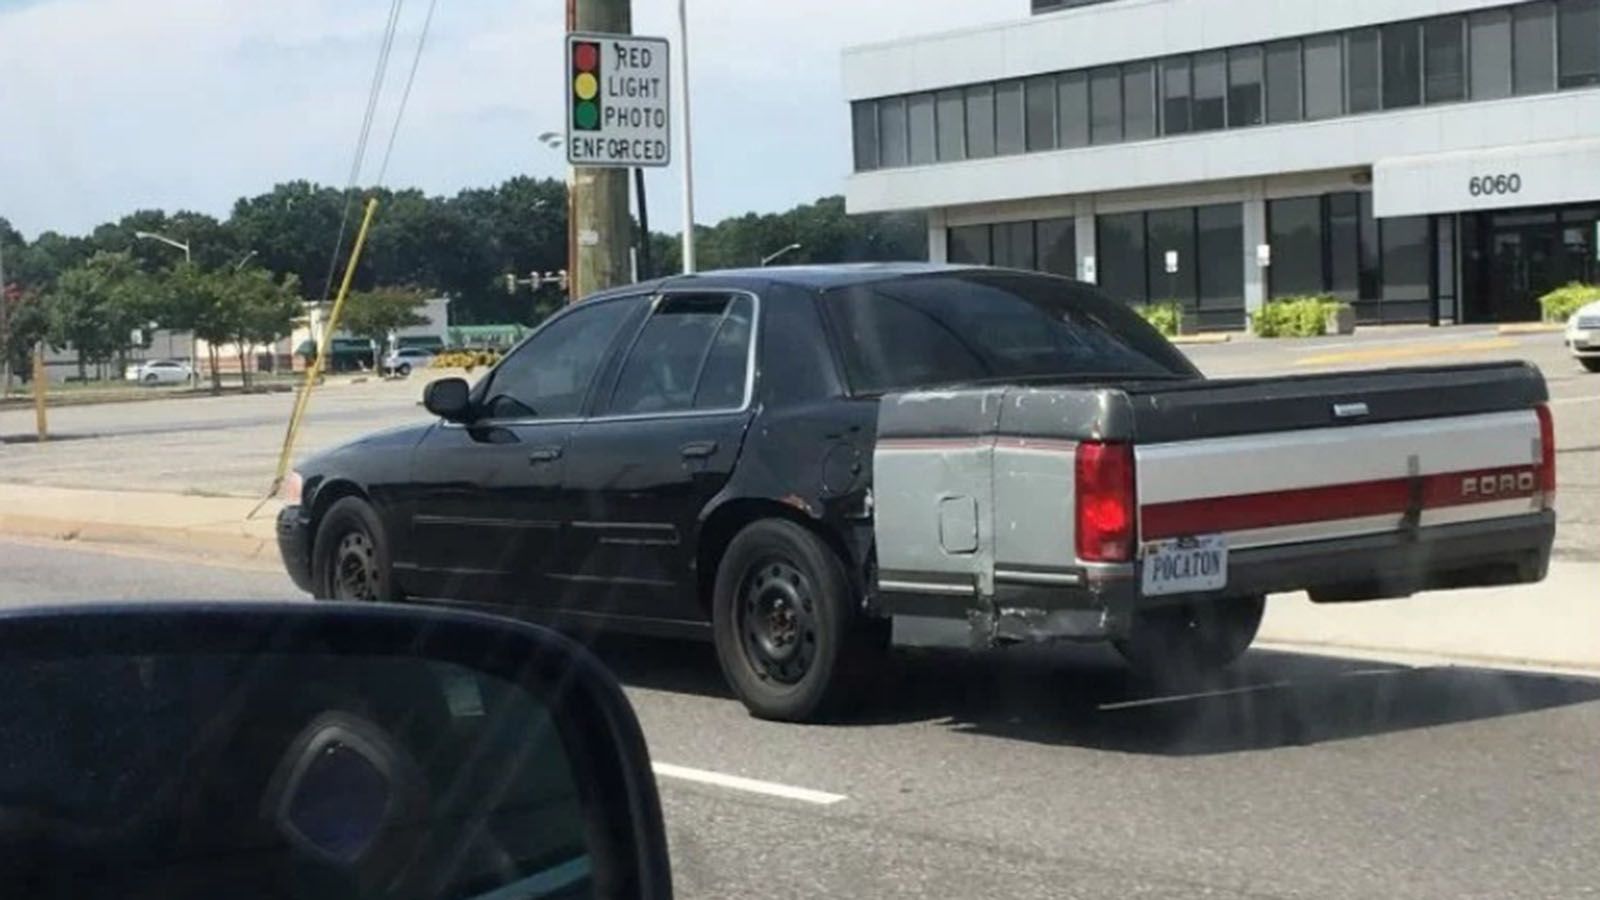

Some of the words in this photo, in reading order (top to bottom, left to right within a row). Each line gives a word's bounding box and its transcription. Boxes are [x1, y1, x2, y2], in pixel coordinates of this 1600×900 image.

[616, 46, 651, 69] RED
[608, 76, 660, 97] LIGHT
[604, 106, 665, 128] PHOTO
[572, 138, 665, 159] ENFORCED
[1469, 173, 1521, 197] 6060
[1462, 472, 1533, 496] FORD
[1152, 550, 1220, 582] POCATON
